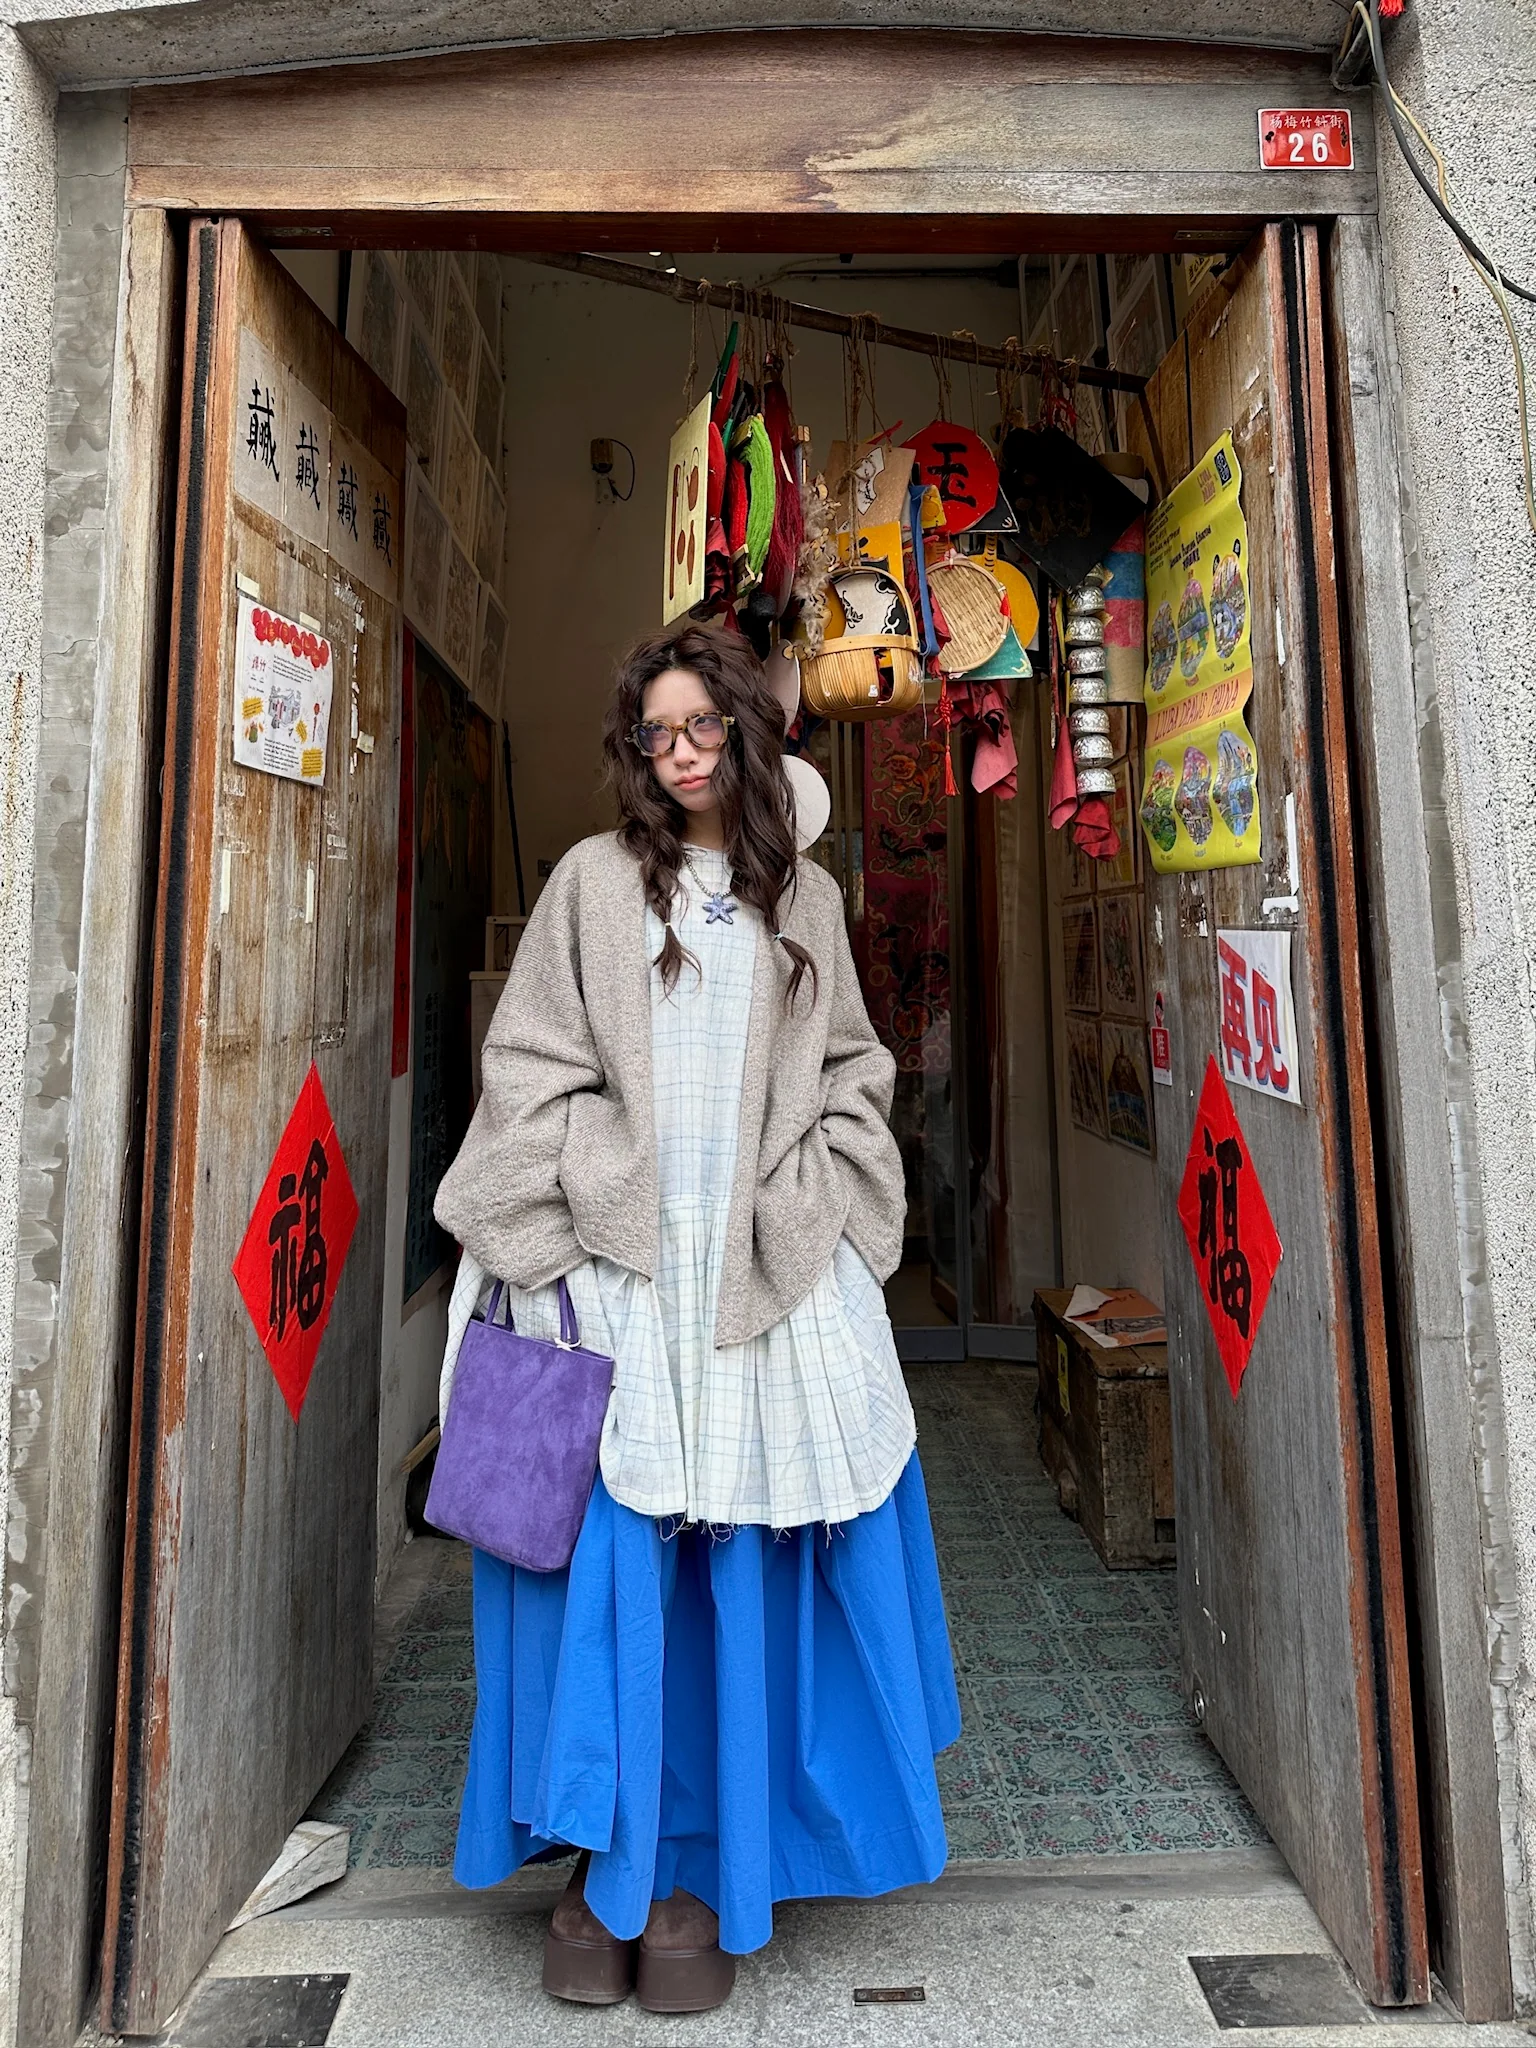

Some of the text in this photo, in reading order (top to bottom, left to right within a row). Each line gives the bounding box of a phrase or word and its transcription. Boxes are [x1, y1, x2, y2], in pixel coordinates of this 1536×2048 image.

[1270, 114, 1343, 129] 杨梅竹斜街
[1288, 132, 1329, 163] 26
[1207, 679, 1239, 719] CHINA
[1218, 936, 1290, 1094] 再见
[268, 1139, 329, 1343] 福
[1198, 1125, 1252, 1341] 福
